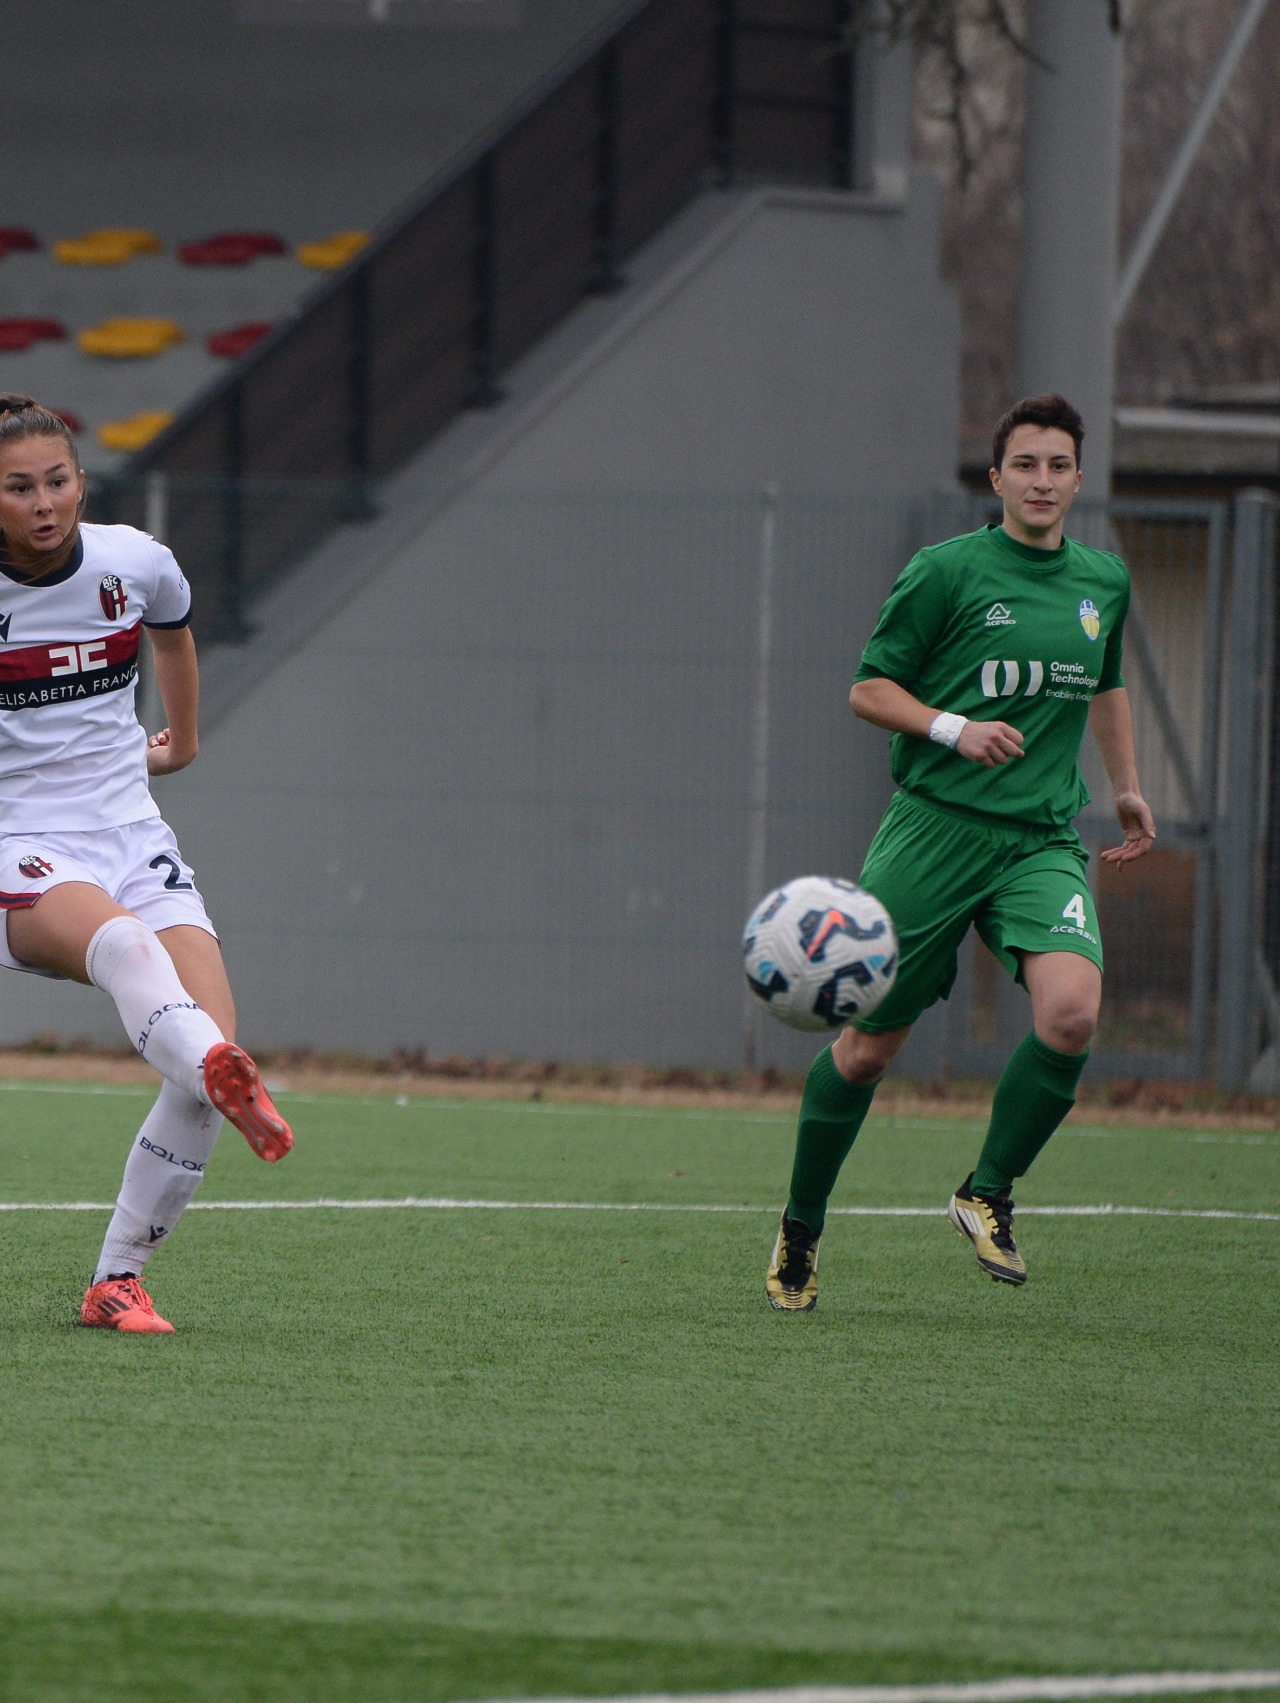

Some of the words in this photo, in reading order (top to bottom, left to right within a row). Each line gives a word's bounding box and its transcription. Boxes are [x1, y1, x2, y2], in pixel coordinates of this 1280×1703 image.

[102, 576, 119, 590] BFC
[93, 662, 139, 692] FRANC
[1050, 661, 1085, 674] Omnia
[148, 854, 194, 891] 2
[1063, 894, 1086, 928] 4
[1050, 925, 1096, 945] ACERBIS
